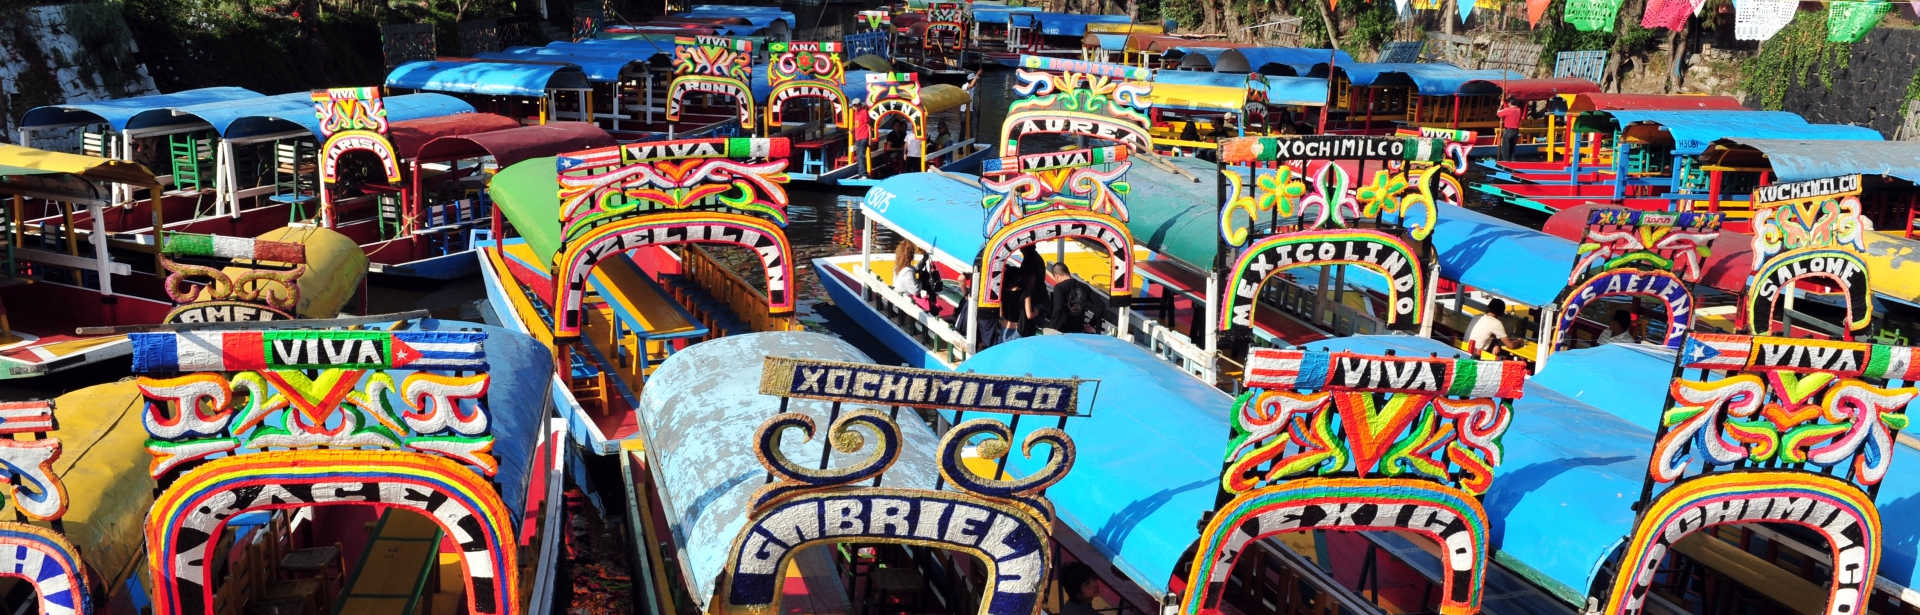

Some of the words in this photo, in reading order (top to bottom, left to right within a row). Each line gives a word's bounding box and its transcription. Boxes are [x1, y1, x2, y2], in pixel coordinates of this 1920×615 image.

[696, 36, 727, 47] VIVA
[331, 88, 355, 99] VIVA
[671, 82, 749, 122] VERONICA
[772, 86, 842, 113] LILIANA
[869, 100, 921, 121] DAFNE
[1021, 119, 1137, 151] AUREA
[1277, 139, 1403, 158] XOCHIMILCO
[1422, 130, 1452, 139] VIVA
[327, 138, 393, 176] MARISOL
[626, 143, 716, 160] VIVA
[1024, 153, 1087, 170] VIVA
[990, 224, 1126, 296] ANGELICA
[1759, 258, 1861, 301] SALOME
[273, 339, 383, 365] VIVA
[1763, 343, 1857, 370] VIVA
[801, 365, 1059, 410] XOCHIMILCO
[1342, 357, 1442, 390] VIVA
[175, 482, 494, 585] ARACELI
[738, 498, 1042, 594] GABRIELA
[1210, 503, 1474, 583] MEXICO
